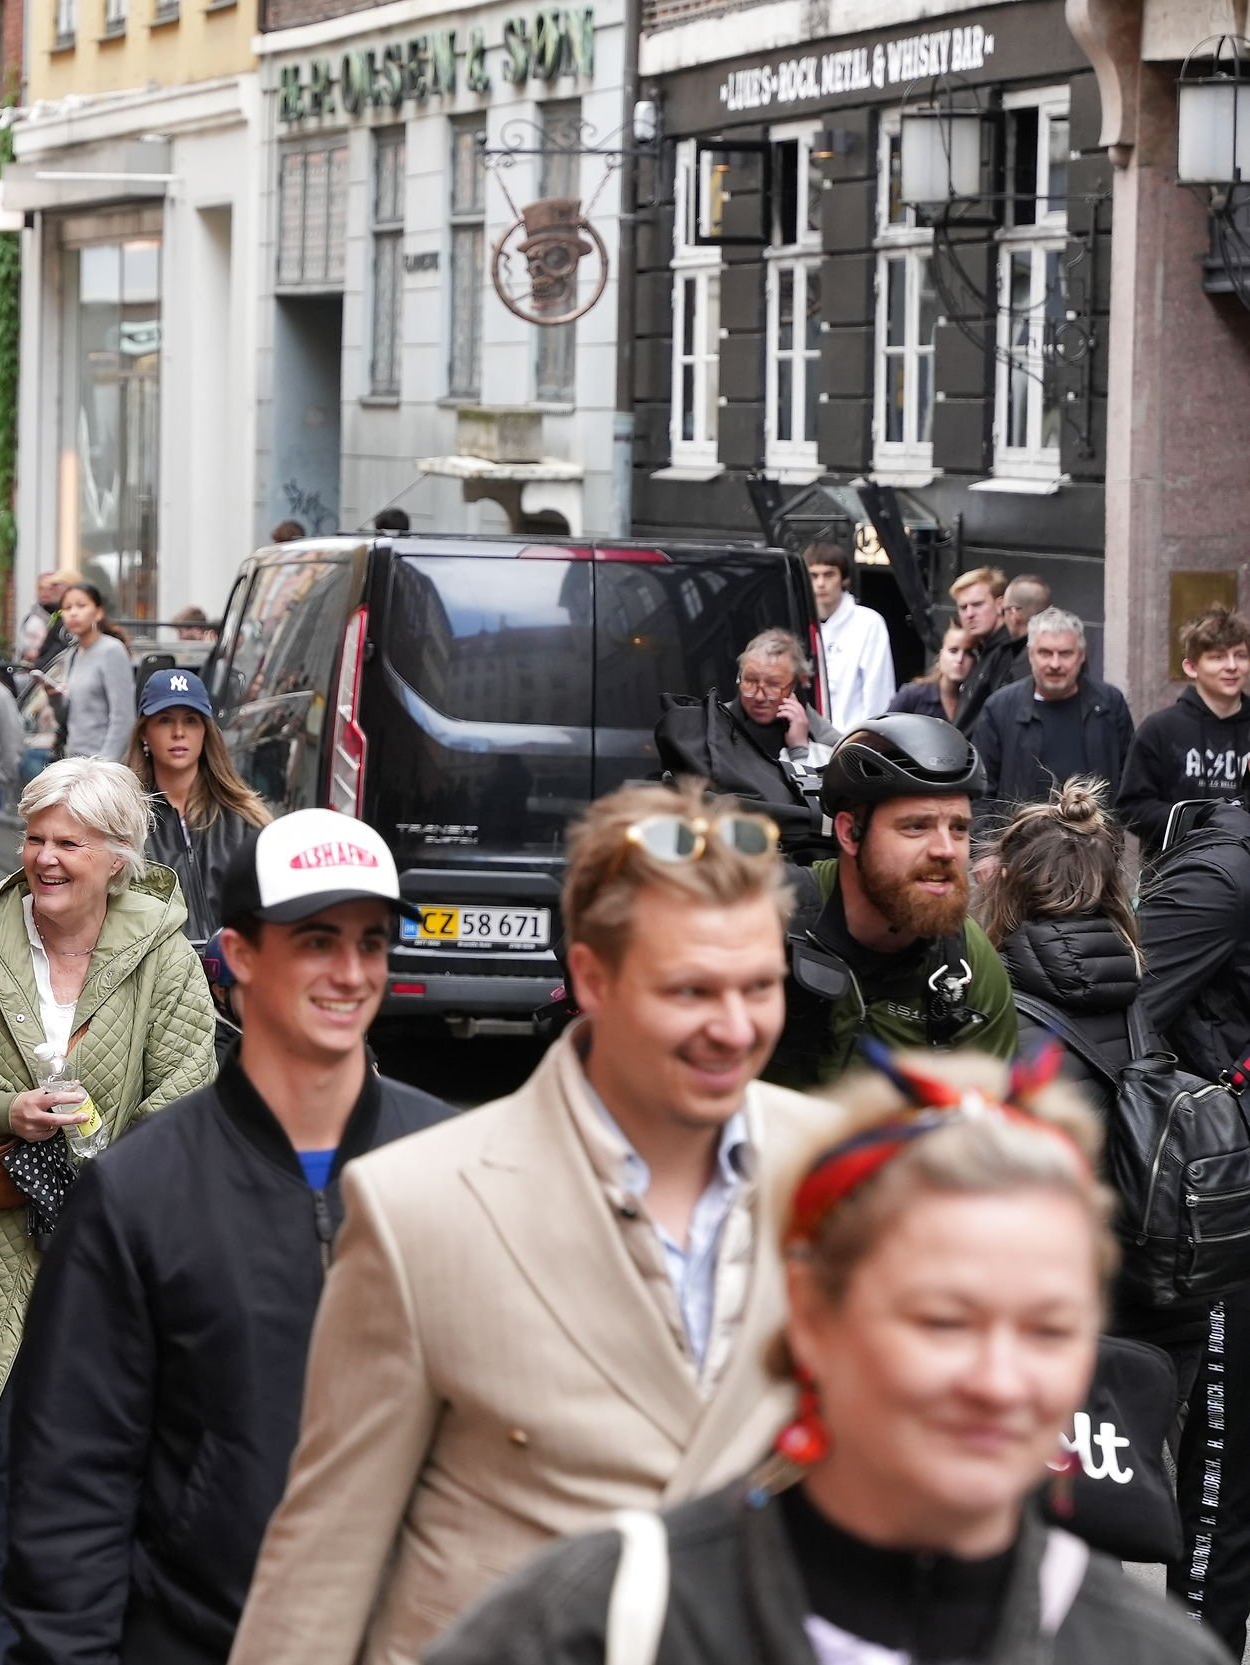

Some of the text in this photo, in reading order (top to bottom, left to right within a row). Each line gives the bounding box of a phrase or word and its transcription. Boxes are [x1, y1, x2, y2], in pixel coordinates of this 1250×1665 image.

[820, 46, 871, 95] METAL
[872, 43, 886, 90] &
[886, 29, 951, 84] WHISKY
[951, 24, 984, 72] BAR
[422, 912, 454, 934] CZ
[462, 914, 491, 936] 58
[499, 914, 541, 938] 671
